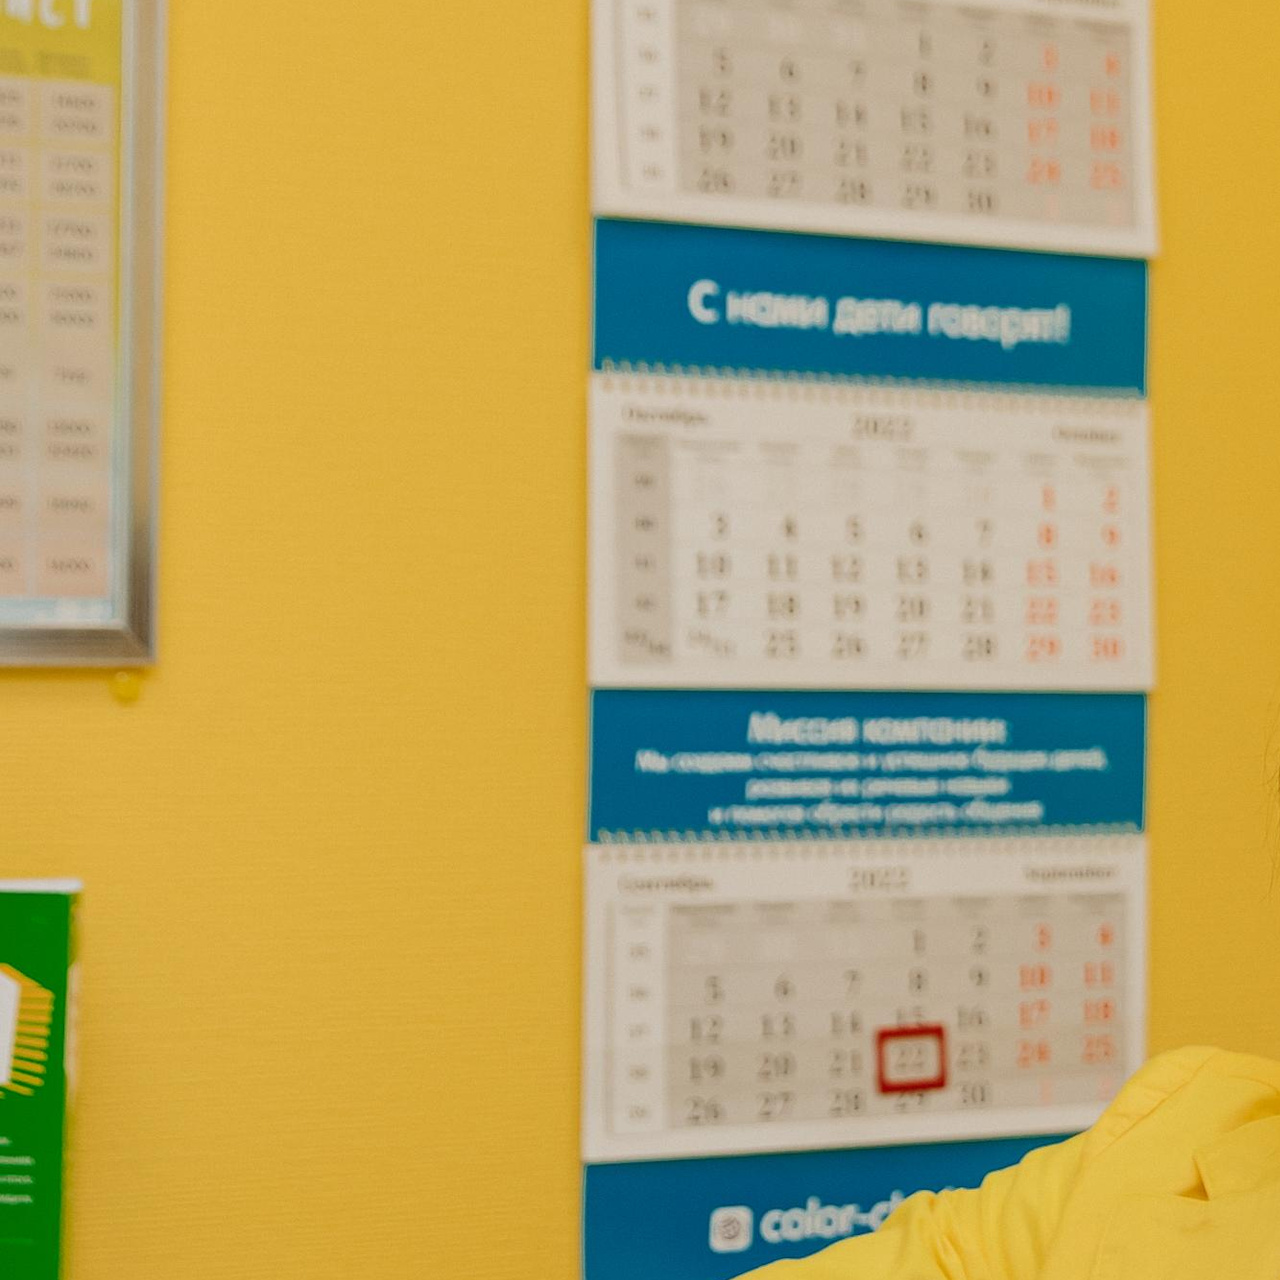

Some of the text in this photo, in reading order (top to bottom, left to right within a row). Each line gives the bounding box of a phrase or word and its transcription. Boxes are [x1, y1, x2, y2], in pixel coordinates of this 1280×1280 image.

[688, 279, 1071, 350] С нами дети говорят!
